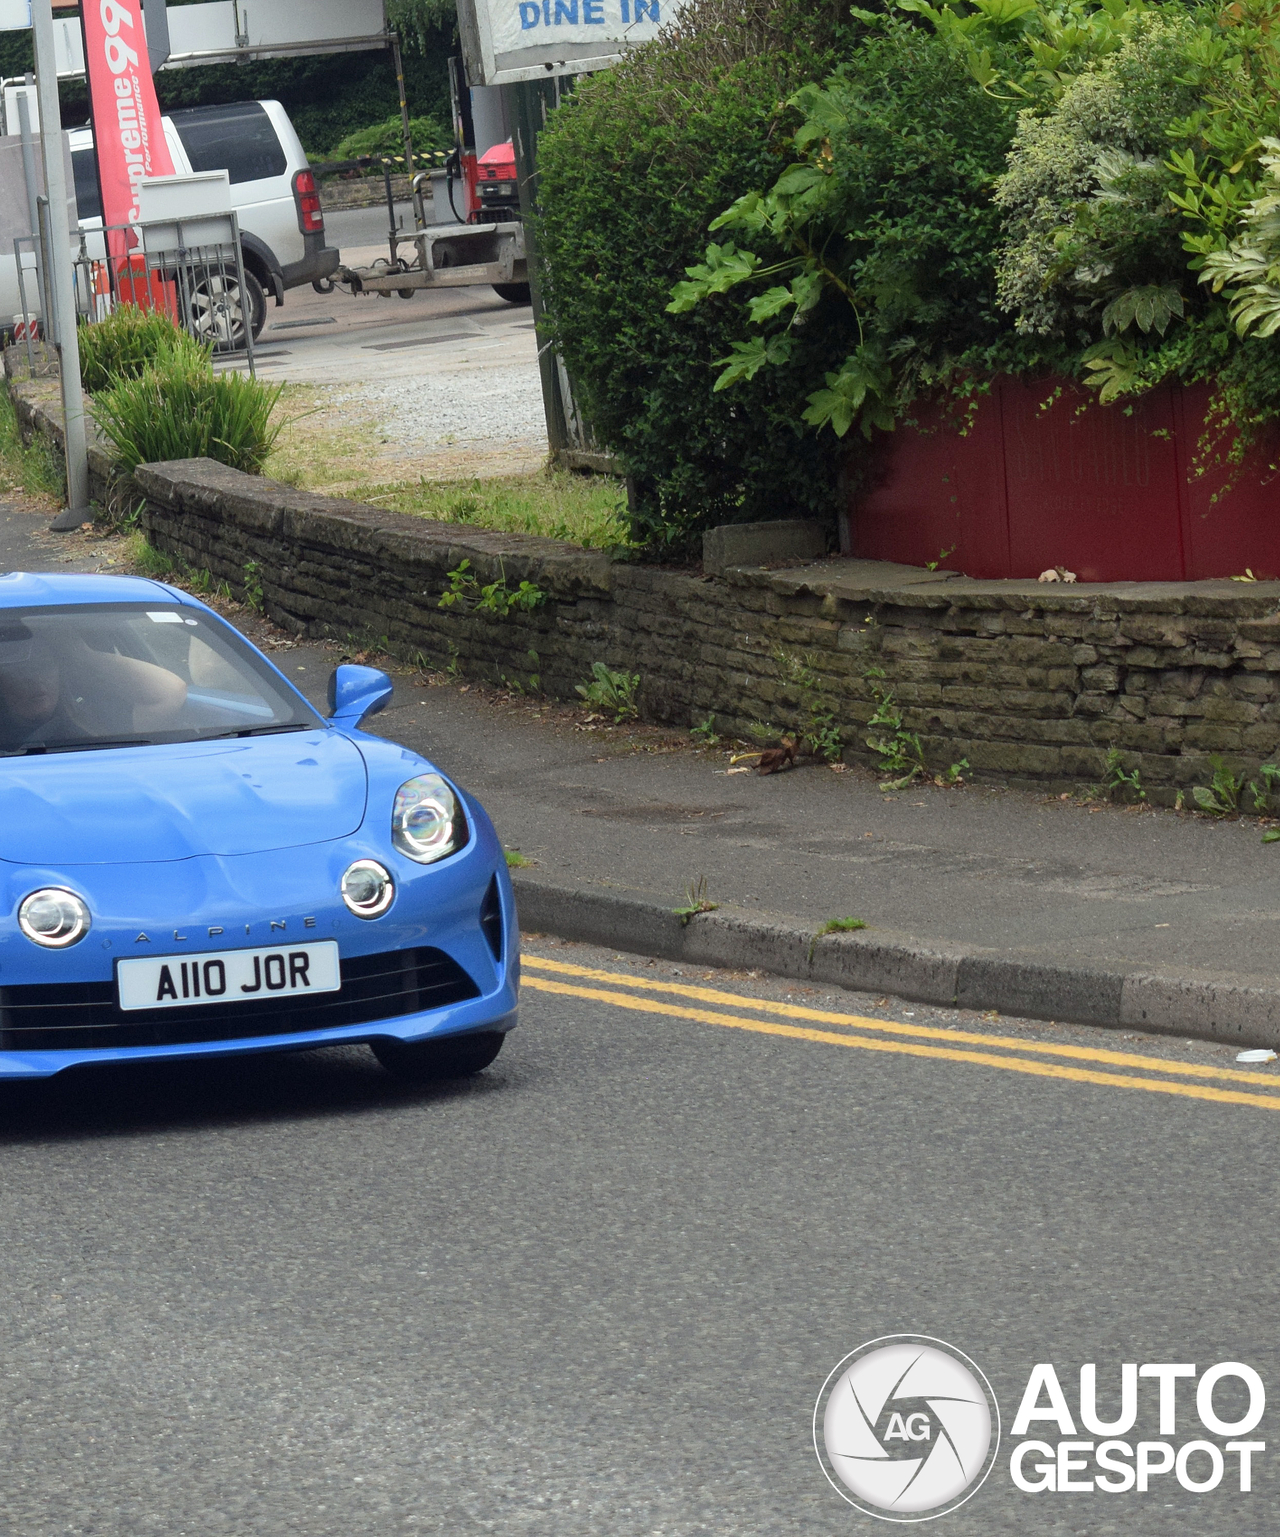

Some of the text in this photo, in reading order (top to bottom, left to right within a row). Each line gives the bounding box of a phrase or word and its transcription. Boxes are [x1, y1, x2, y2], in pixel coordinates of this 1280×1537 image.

[520, 0, 660, 30] DINE IN
[100, 0, 139, 75] 99
[135, 916, 316, 943] ALPINE
[156, 951, 311, 1001] A110 JOR
